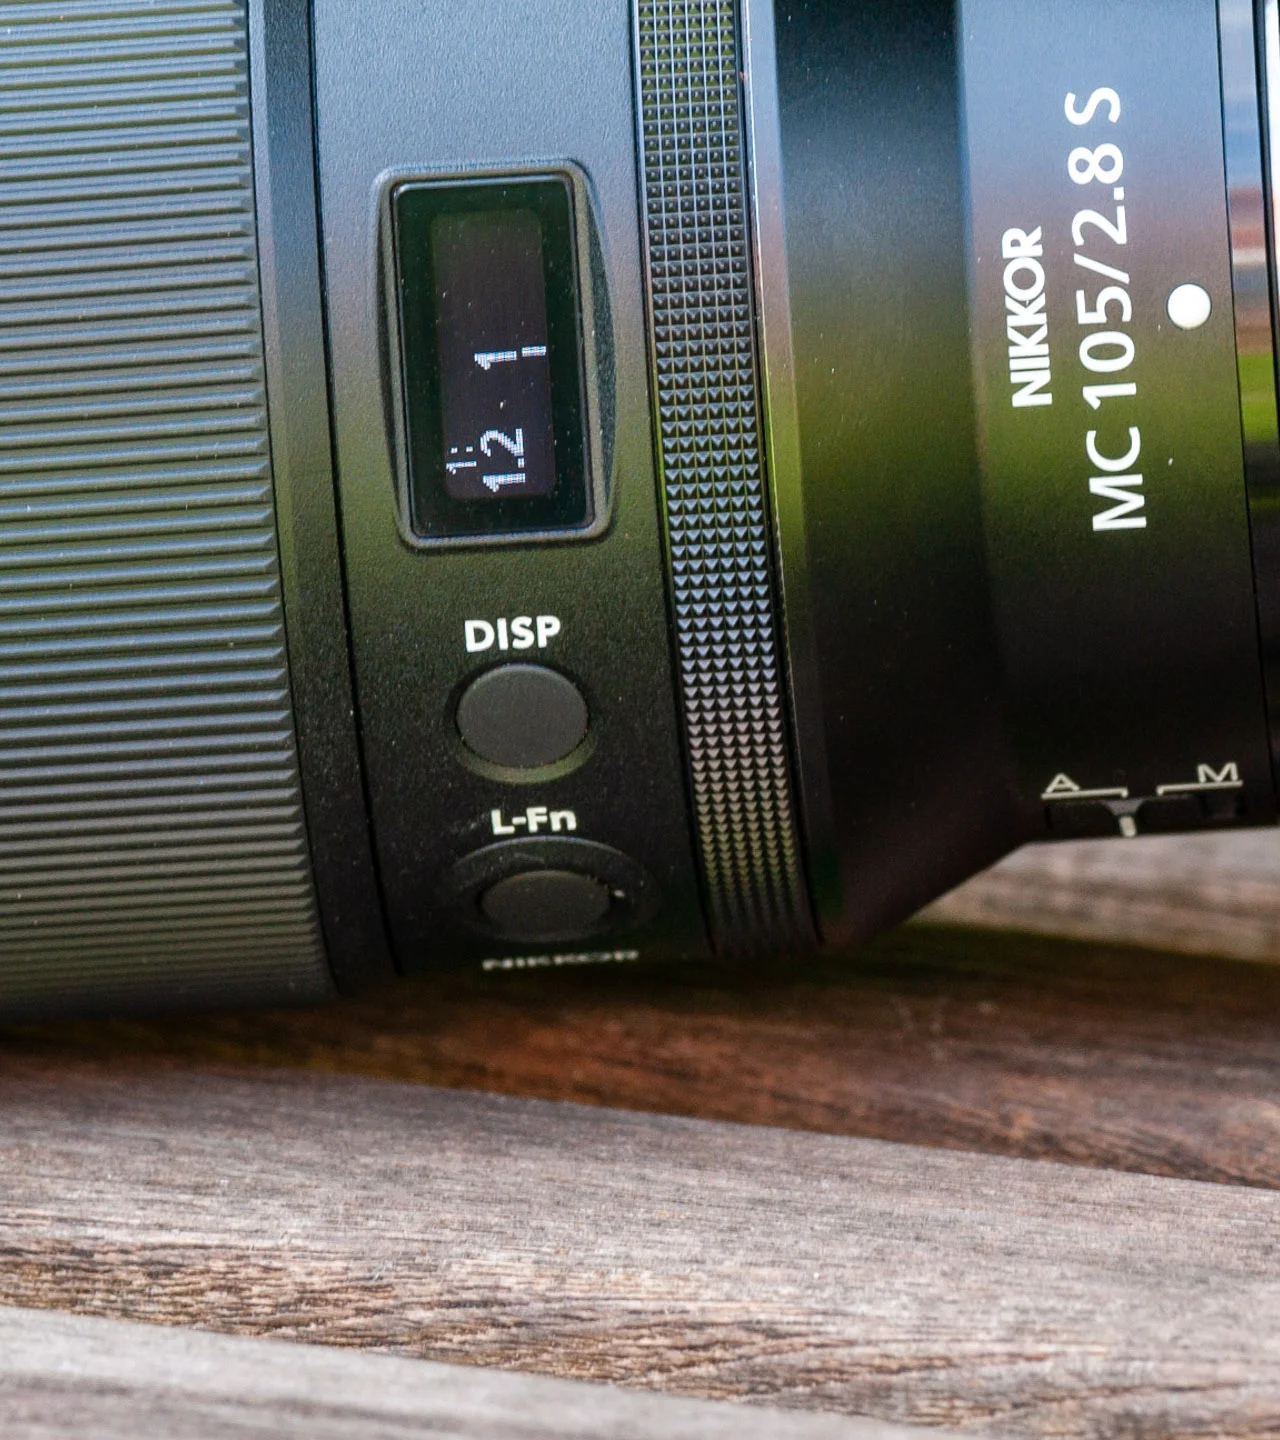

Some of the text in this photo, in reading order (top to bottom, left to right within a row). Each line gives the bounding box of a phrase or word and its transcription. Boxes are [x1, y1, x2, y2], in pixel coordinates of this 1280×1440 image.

[1002, 226, 1052, 407] NIKKOR
[1065, 88, 1146, 530] MC 105/2.8 S
[480, 429, 525, 492] 1.2
[465, 616, 560, 652] DISP
[1046, 773, 1076, 792] A
[1197, 763, 1239, 783] M
[492, 807, 576, 834] L-Fn
